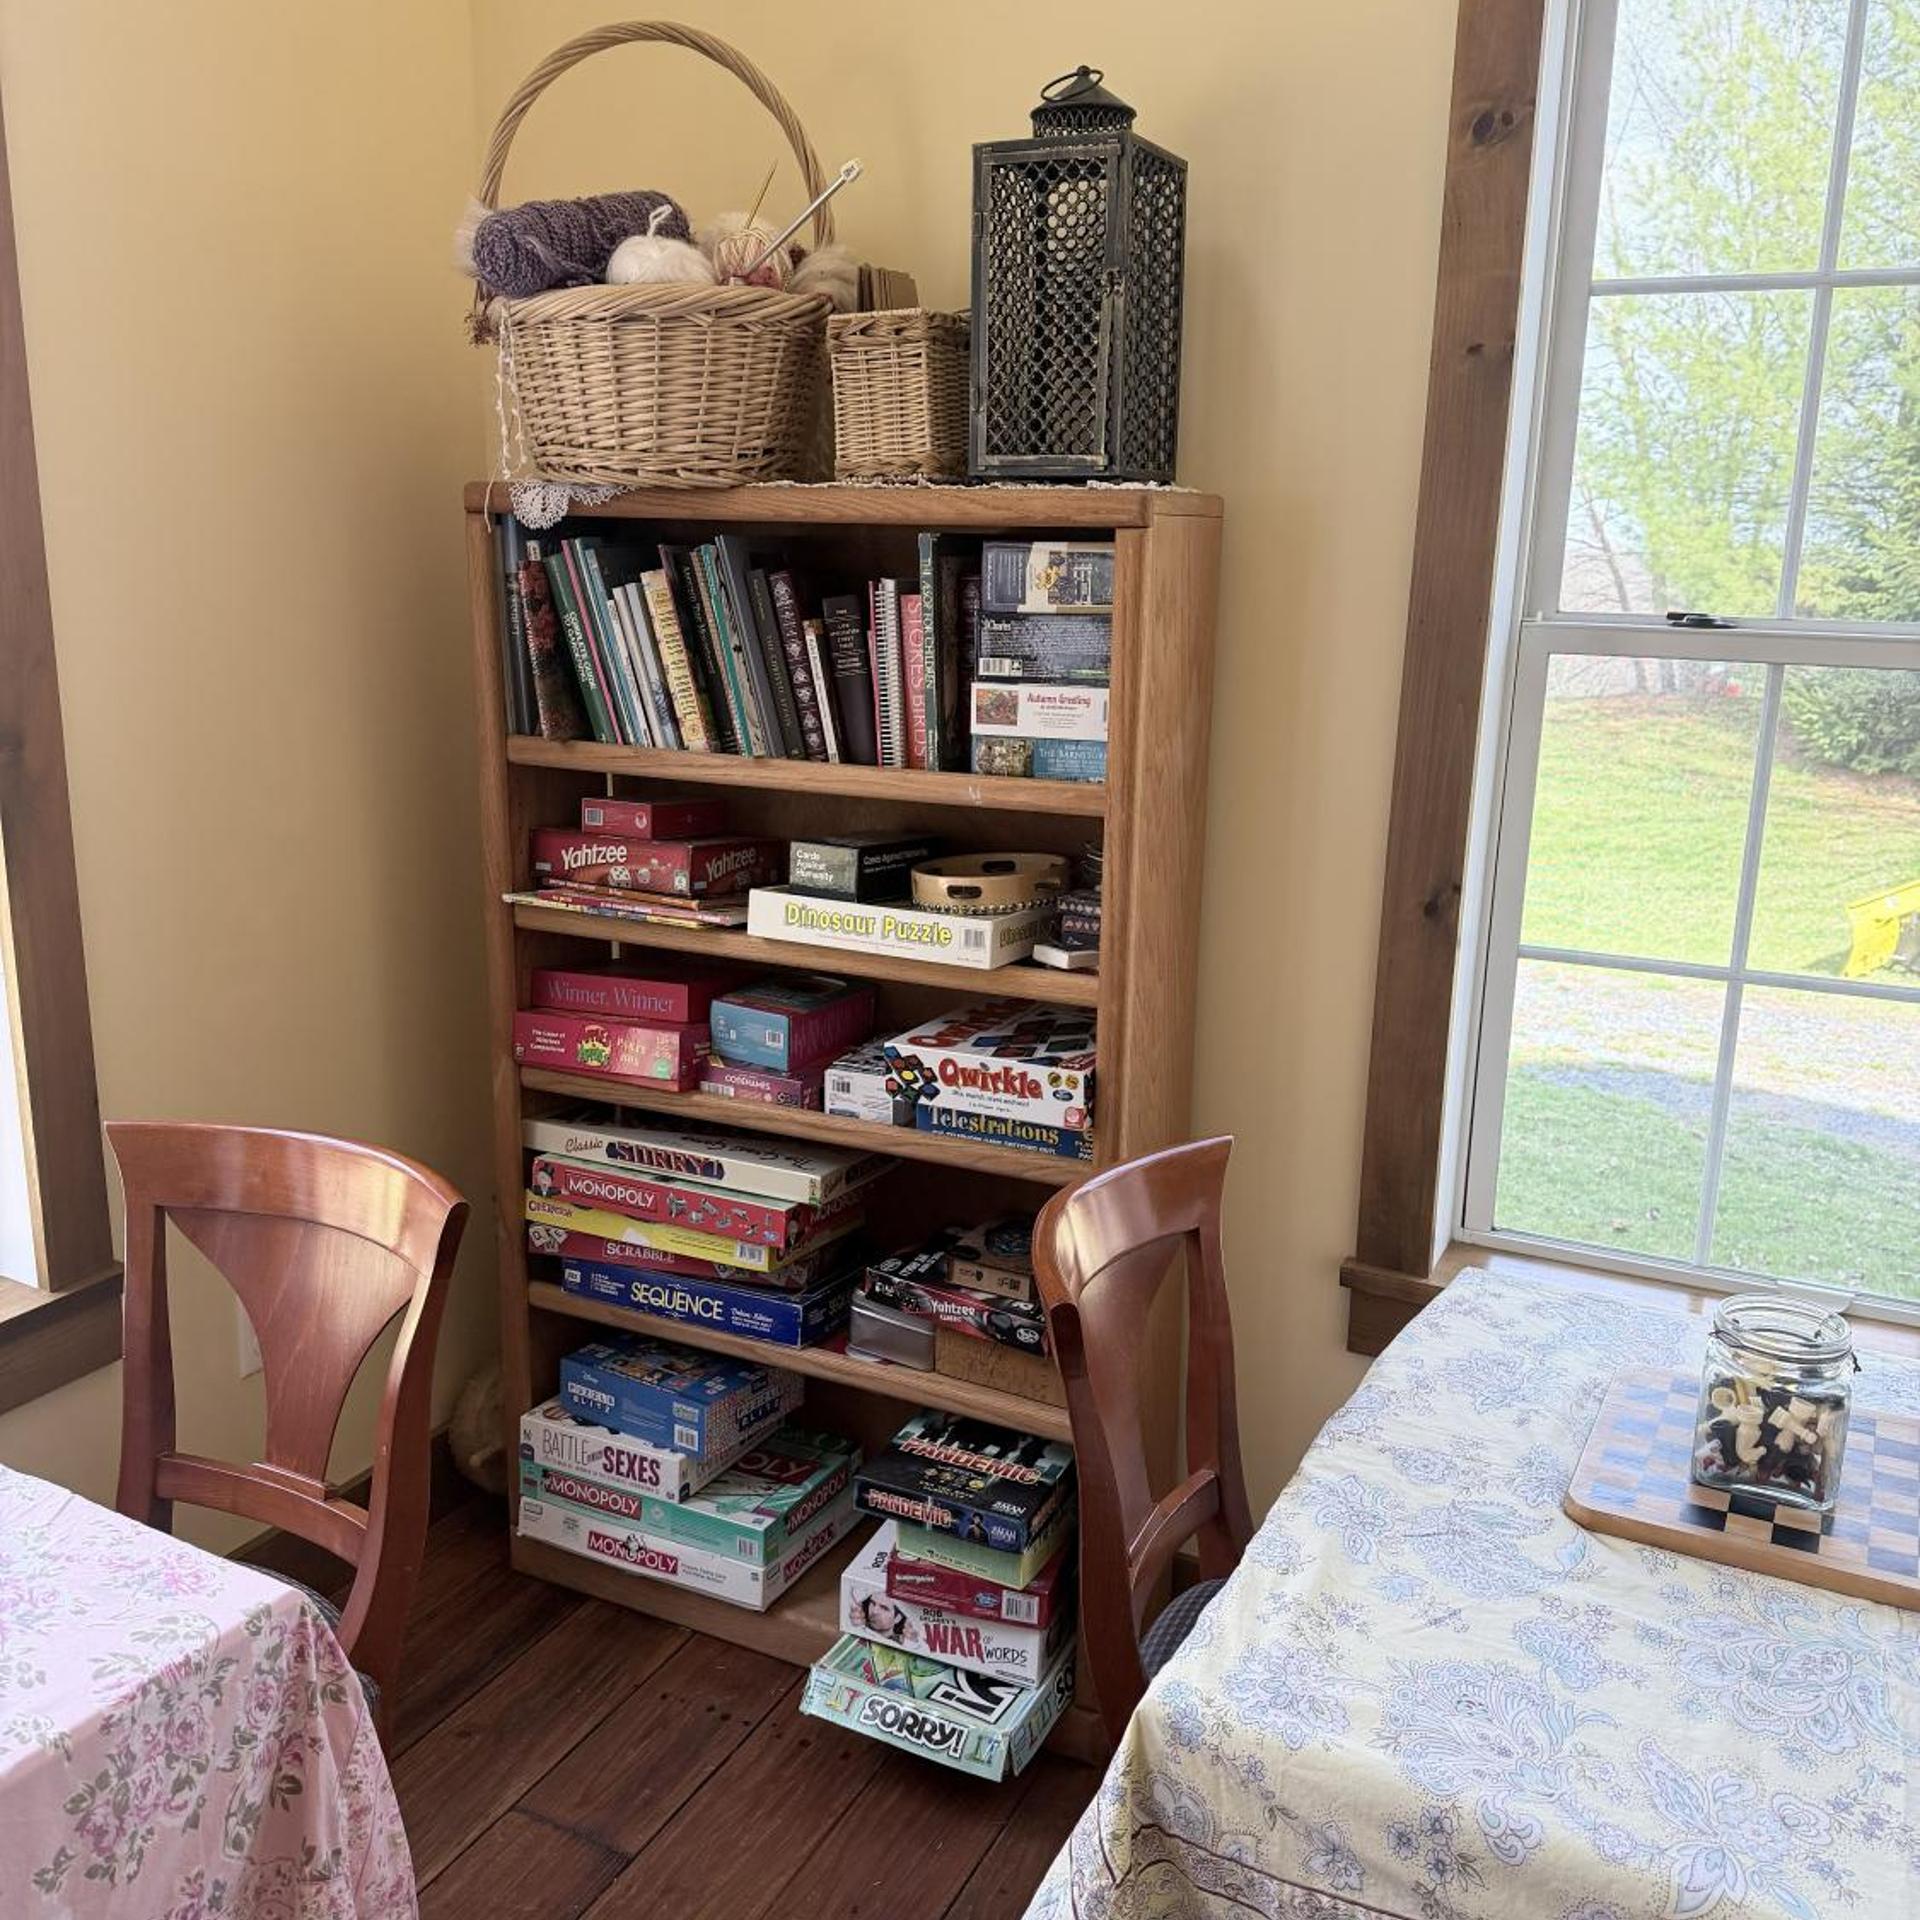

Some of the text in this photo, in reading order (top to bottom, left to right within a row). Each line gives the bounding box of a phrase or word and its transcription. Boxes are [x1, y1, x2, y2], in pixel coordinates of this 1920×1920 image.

[922, 612, 933, 632] FOR
[907, 601, 926, 757] STOKES BIRDS
[922, 636, 934, 689] CHILDREN
[1027, 693, 1057, 703] Autumn
[561, 845, 628, 870] Yahtzee
[706, 846, 756, 882] Yahtzee
[796, 850, 820, 861] Cards
[797, 858, 826, 870] Against
[787, 903, 876, 934] Dinosaur
[883, 915, 953, 946] Puzzle
[614, 986, 674, 1013] Winner
[724, 1074, 771, 1091] CODENAMES
[938, 1058, 1043, 1100] Qwirkle
[927, 1106, 1060, 1146] Telestrations
[565, 1136, 604, 1153] Classic
[569, 1177, 655, 1208] MONOPOLY
[607, 1242, 675, 1263] SCRABBLE
[630, 1282, 726, 1321] SEQUENCE
[930, 1300, 976, 1315] Yahtzee
[542, 1429, 589, 1466] BATTLE
[902, 1437, 1041, 1484] PANDEMIC
[603, 1446, 661, 1486] SEXES
[550, 1476, 638, 1515] MONOPOLY
[788, 1471, 846, 1531] MONOPOLY
[867, 1488, 952, 1527] PANDEMIC
[589, 1533, 678, 1573] MONOPOLY
[872, 1551, 888, 1569] ROB
[922, 1608, 943, 1618] ROB
[923, 1622, 985, 1664] WAR
[985, 1645, 1028, 1665] WORDS
[861, 1696, 968, 1758] SORRY!
